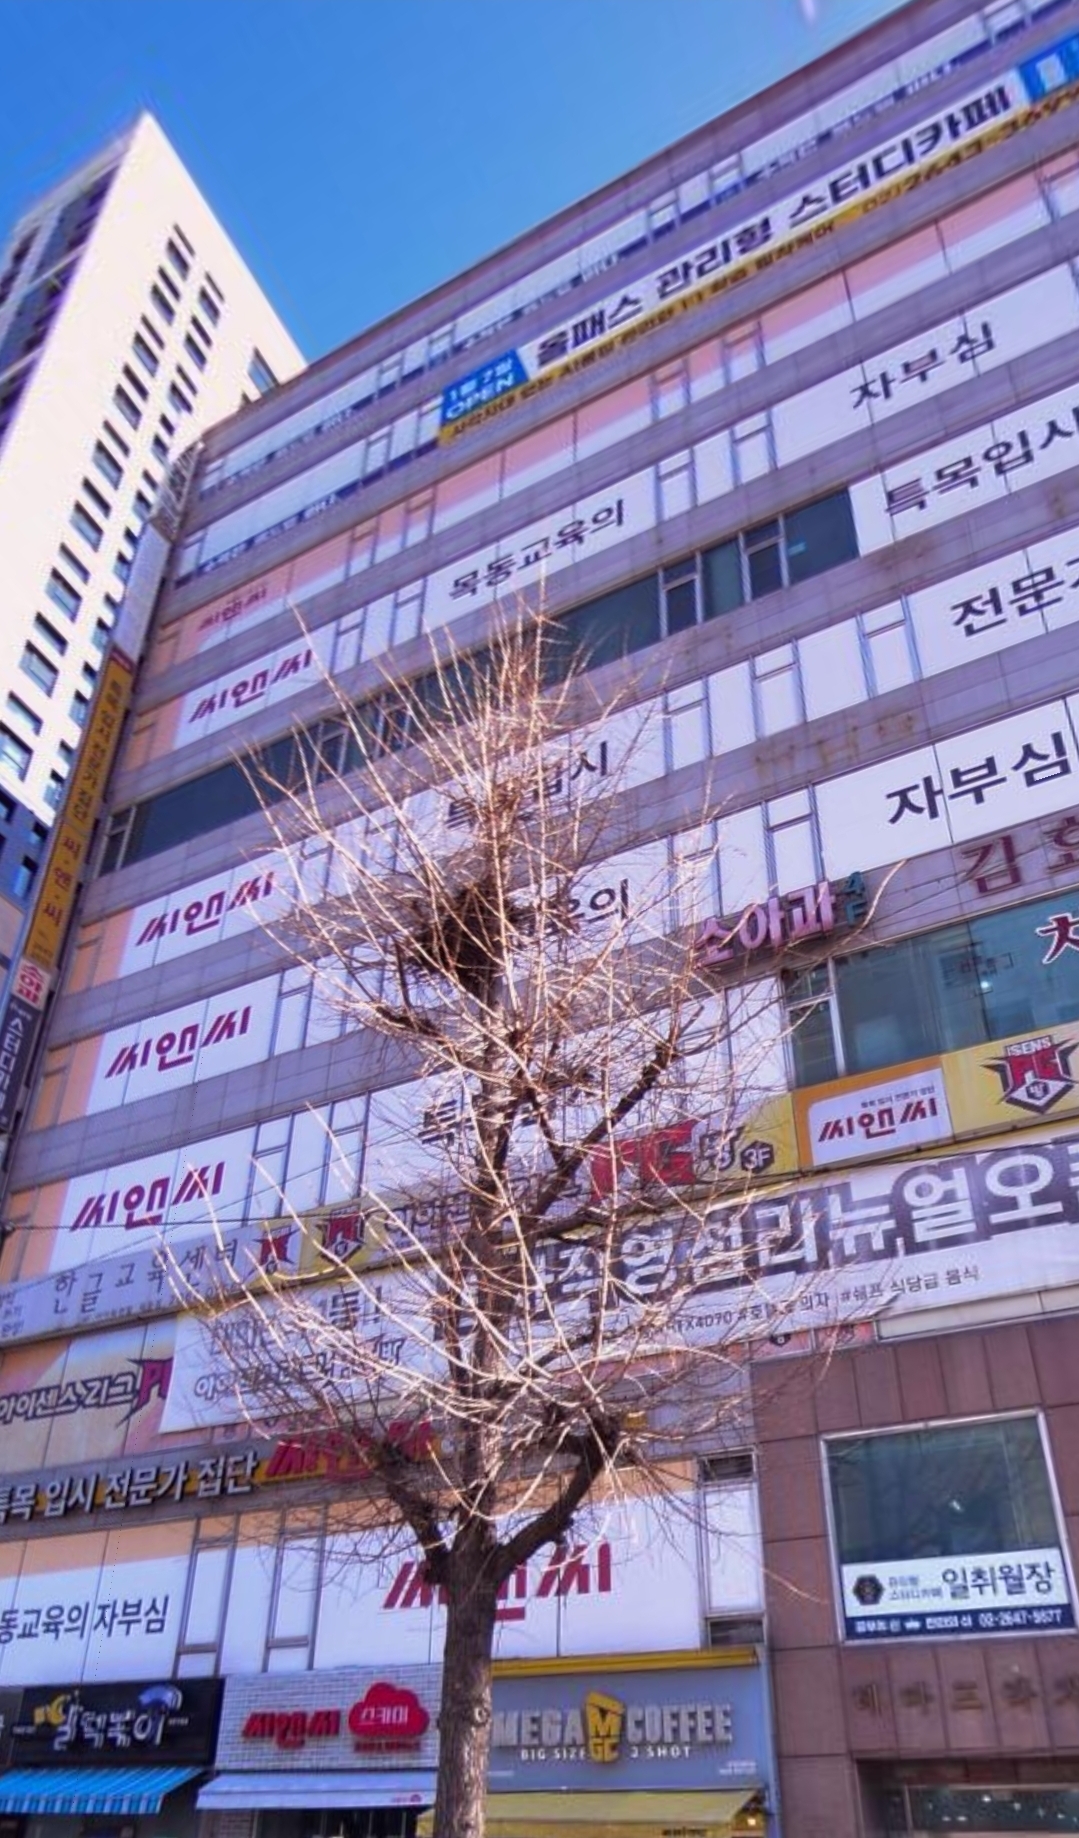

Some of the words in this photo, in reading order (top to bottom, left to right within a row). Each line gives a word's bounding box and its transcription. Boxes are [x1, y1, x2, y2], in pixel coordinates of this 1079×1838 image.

[656, 216, 774, 299] 관리형
[789, 86, 1010, 229] 스터디카페
[850, 321, 996, 409] 자부심
[450, 499, 624, 601] 목동교육의
[886, 731, 1072, 824] 자부심
[136, 871, 274, 947] 씨앤씨
[105, 1005, 252, 1079] 씨앤씨
[818, 1097, 938, 1143] 씨앤씨
[70, 1161, 226, 1232] 씨앤씨
[44, 1472, 99, 1518] 입시
[104, 1460, 190, 1510] 전문가
[198, 1450, 259, 1498] 집단
[941, 1560, 1056, 1601] 일취월장
[93, 1594, 170, 1639] 자부심
[490, 1706, 586, 1748] MEGA
[520, 1748, 546, 1761] BIG
[646, 1745, 691, 1759] SHOT
[625, 1703, 733, 1745] COFFEE
